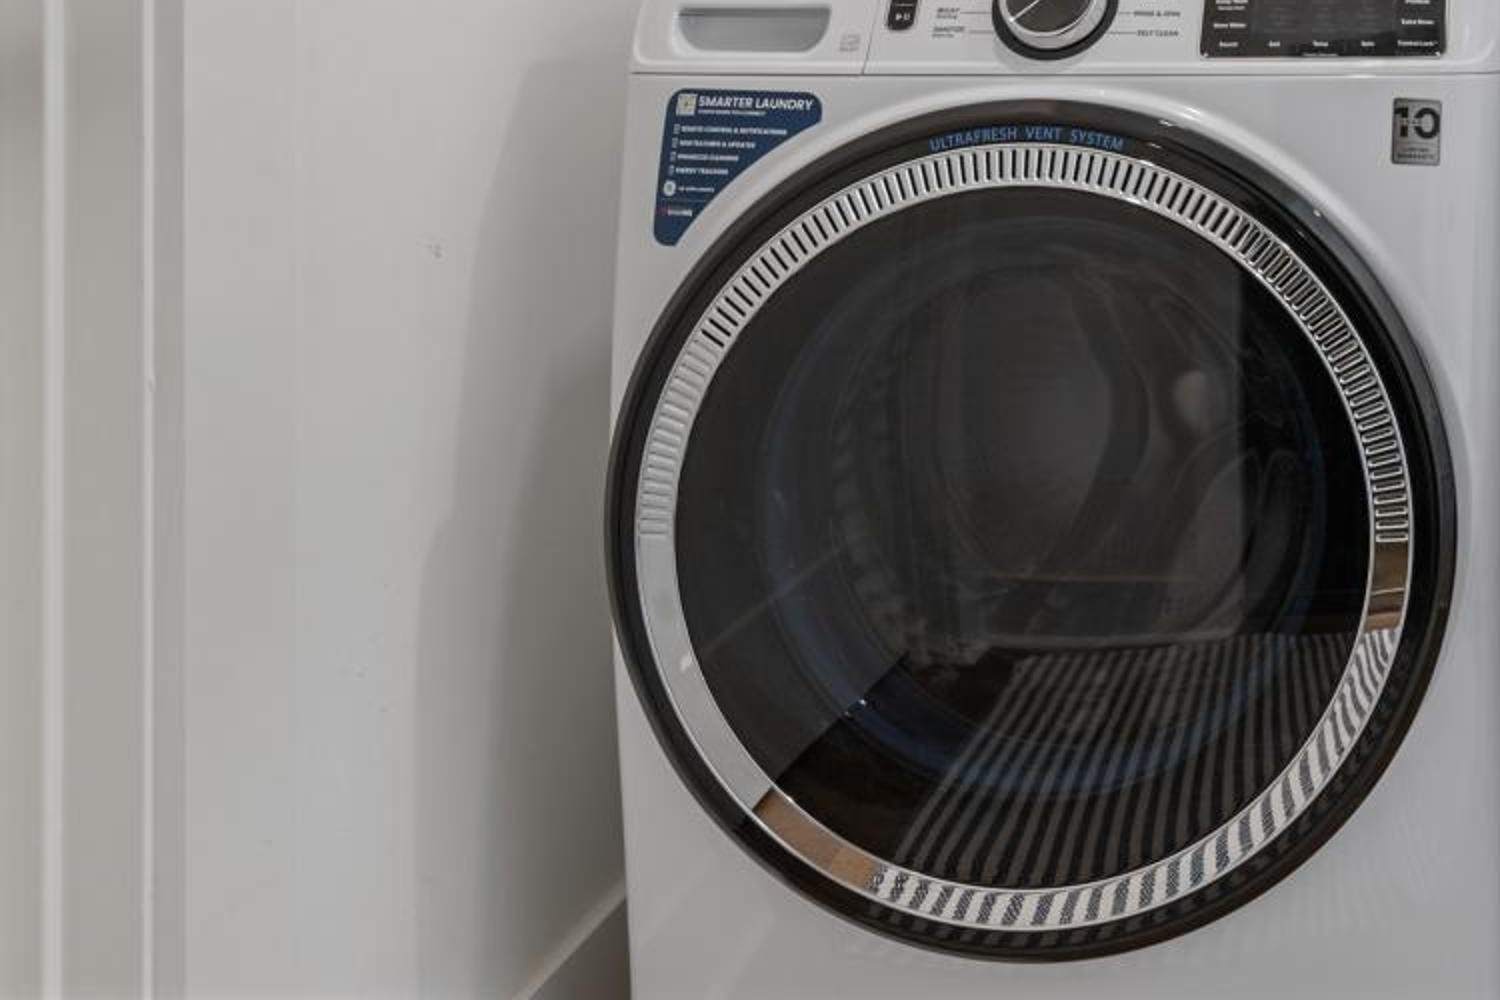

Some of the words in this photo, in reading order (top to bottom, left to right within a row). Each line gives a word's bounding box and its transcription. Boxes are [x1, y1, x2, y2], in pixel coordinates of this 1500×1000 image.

[698, 95, 753, 109] SMARTER
[755, 97, 814, 112] LAUNDRY
[928, 126, 1018, 153] ULTRAFRESH
[1025, 126, 1062, 142] VENT
[1069, 129, 1126, 152] SYSTEM
